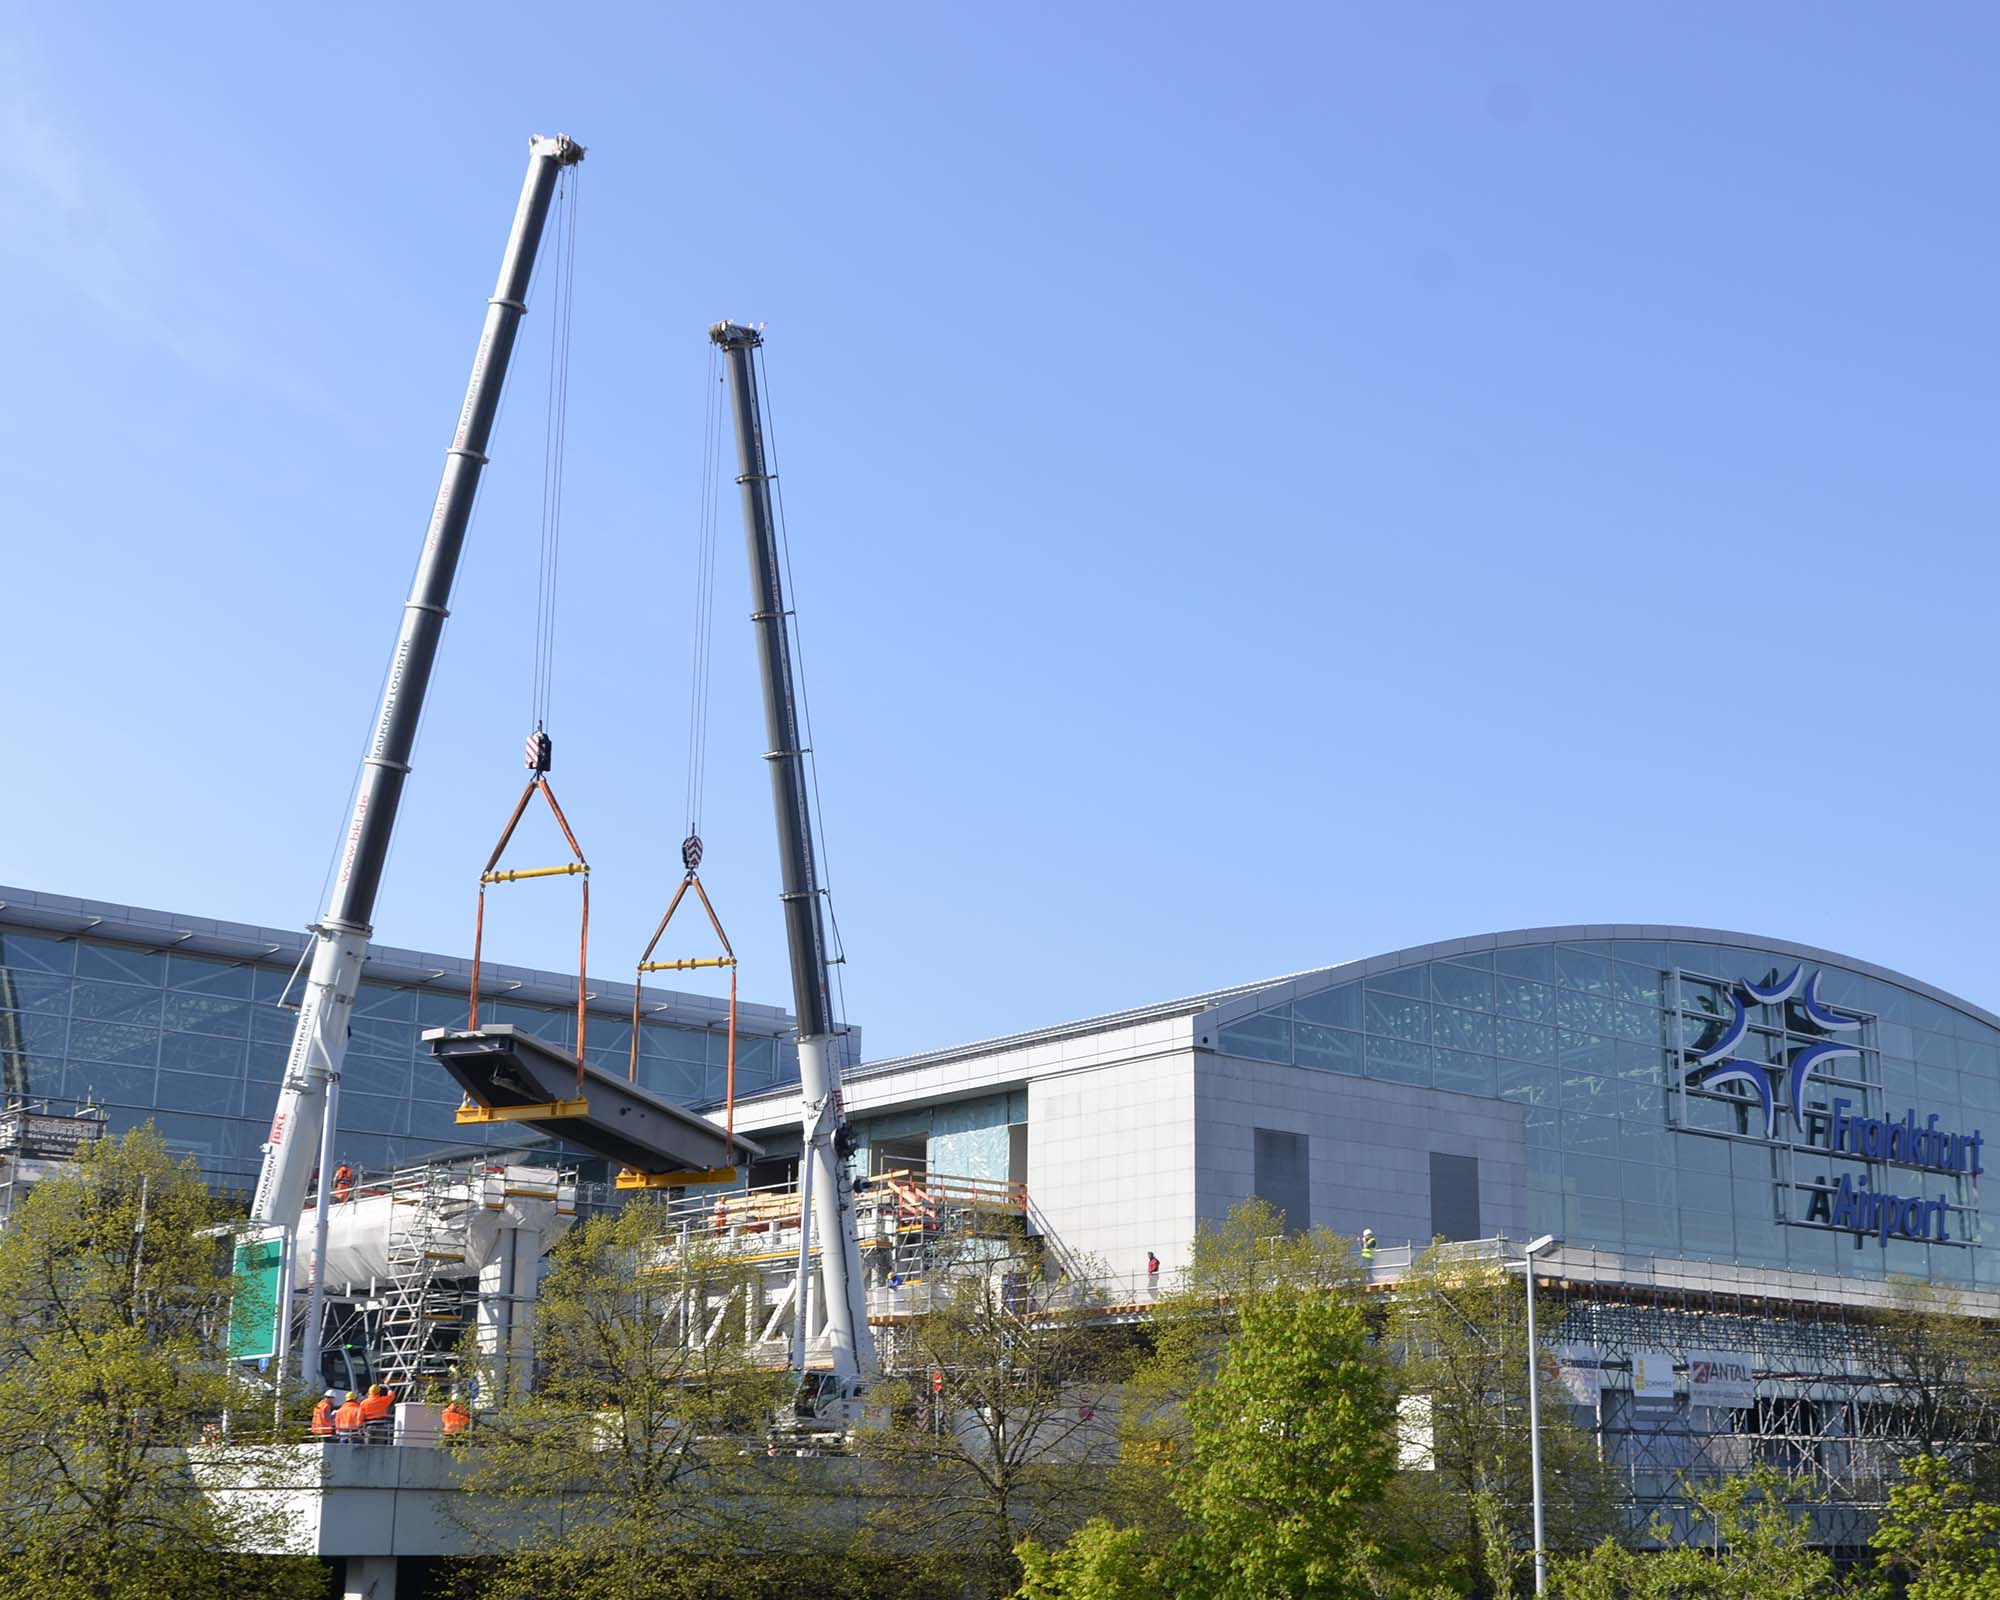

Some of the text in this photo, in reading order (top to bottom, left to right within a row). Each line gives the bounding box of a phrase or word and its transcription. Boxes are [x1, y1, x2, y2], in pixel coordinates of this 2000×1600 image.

[389, 639, 410, 699] LOGISTIK
[342, 794, 369, 881] www.bkl.de
[1832, 1098, 1984, 1175] Frankfurt
[1832, 1173, 1950, 1248] Airport
